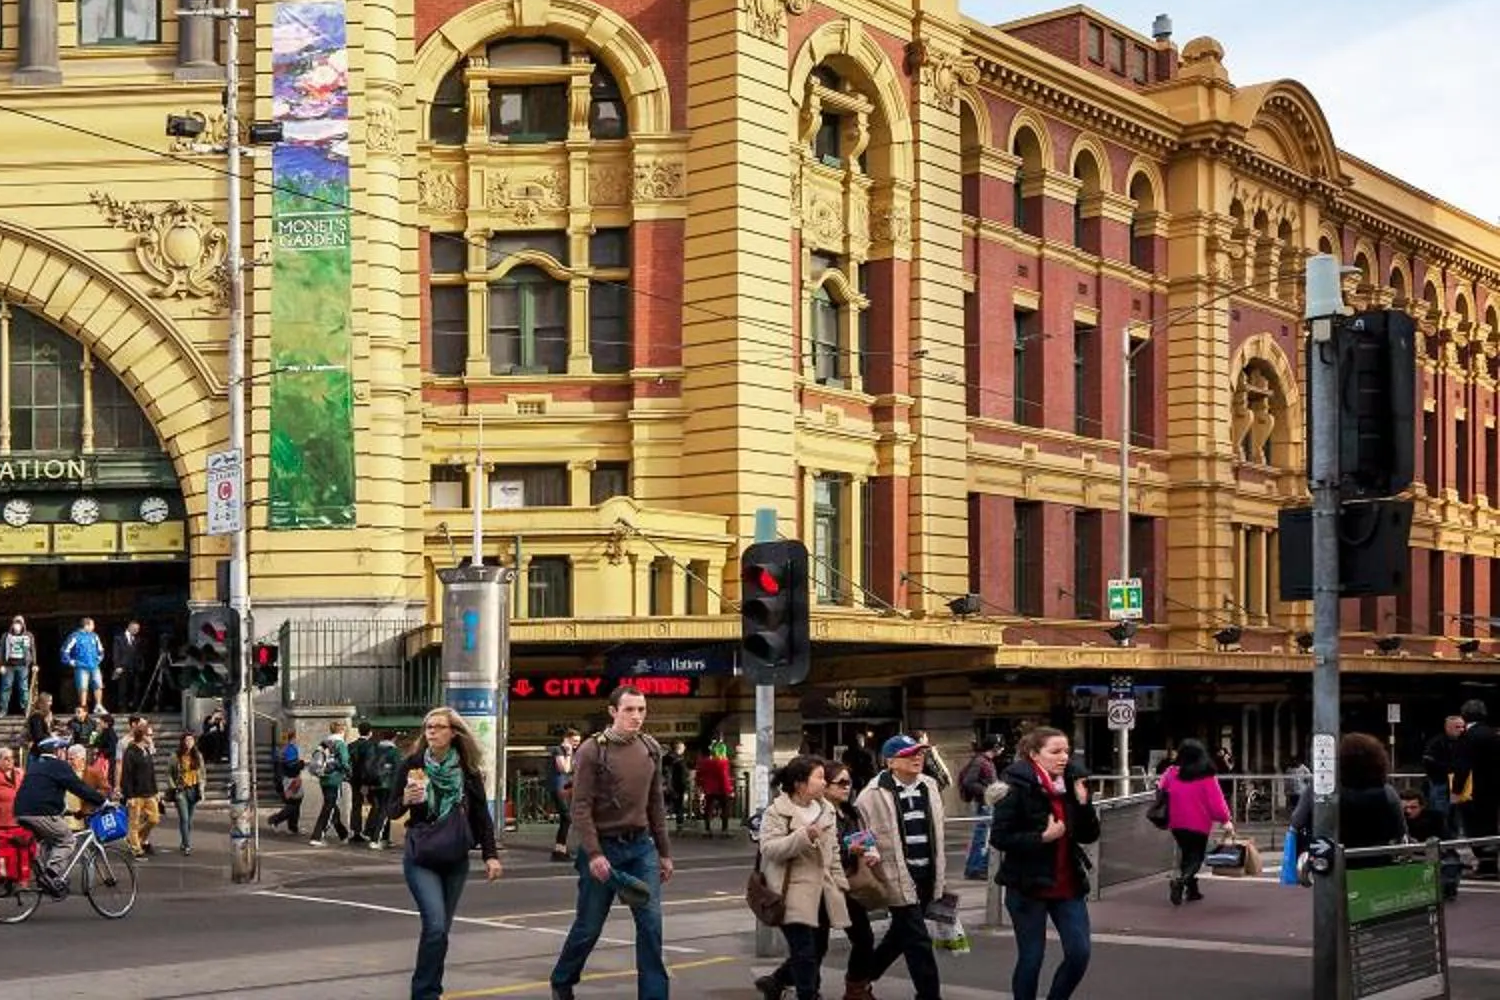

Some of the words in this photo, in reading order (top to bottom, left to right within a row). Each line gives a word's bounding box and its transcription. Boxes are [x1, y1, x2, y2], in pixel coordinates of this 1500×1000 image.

[278, 217, 347, 234] MONET'S
[279, 231, 346, 247] GARDEN
[543, 678, 602, 696] CITY
